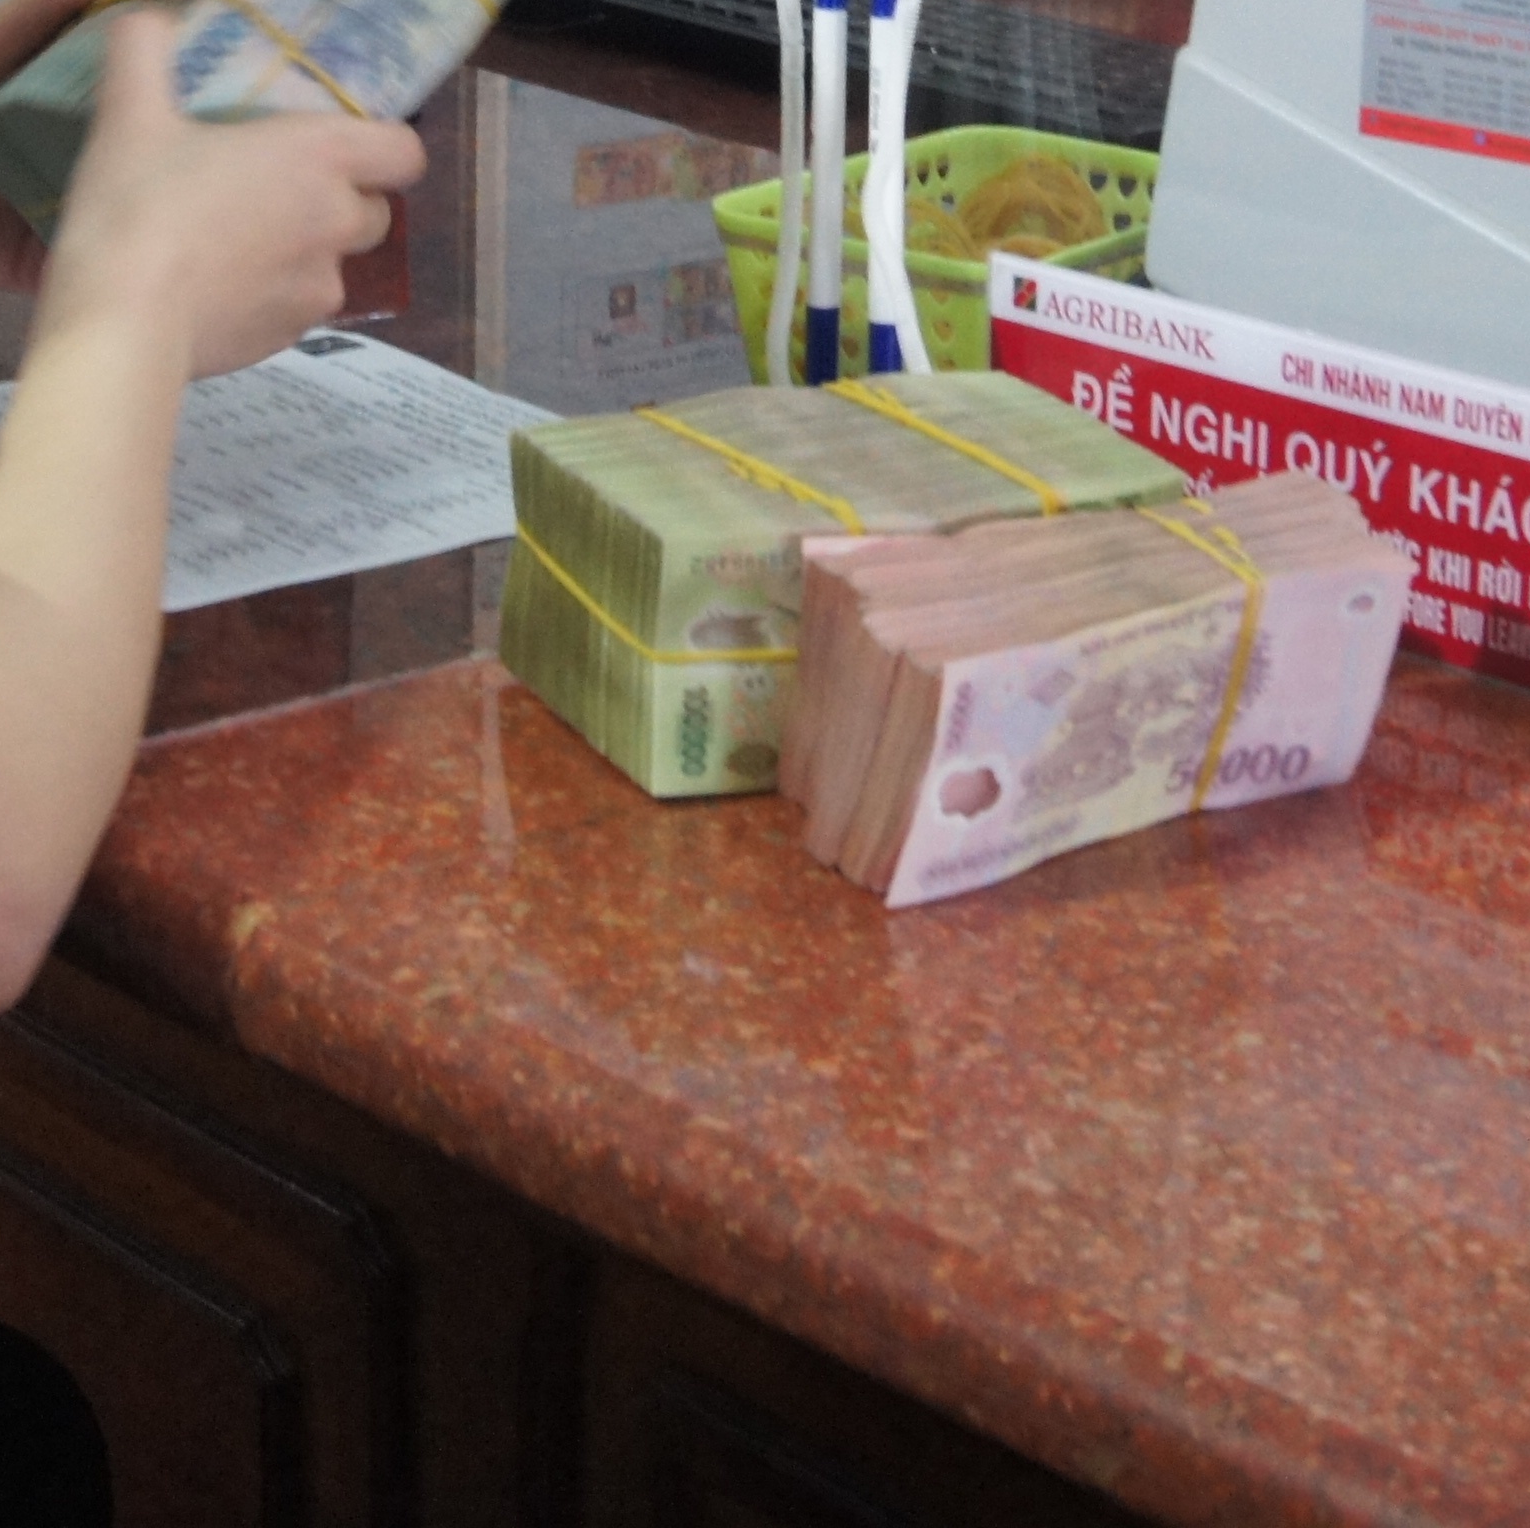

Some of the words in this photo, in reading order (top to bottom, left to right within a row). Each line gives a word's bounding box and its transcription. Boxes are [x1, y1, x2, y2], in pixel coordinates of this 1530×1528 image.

[1044, 290, 1216, 361] AGRIBANK
[1280, 352, 1314, 389] CHI
[1322, 362, 1391, 409] NHÁNH
[1399, 382, 1445, 423] NAM
[1453, 396, 1522, 443] DUYÊN
[1072, 362, 1134, 433] ĐỀ
[1149, 391, 1269, 477] NGHỊ
[1284, 430, 1392, 503] QUÝ
[1427, 545, 1472, 593] KHI
[1476, 556, 1522, 607] RỜI
[1449, 601, 1485, 646] YOU
[1164, 742, 1311, 797] 5000
